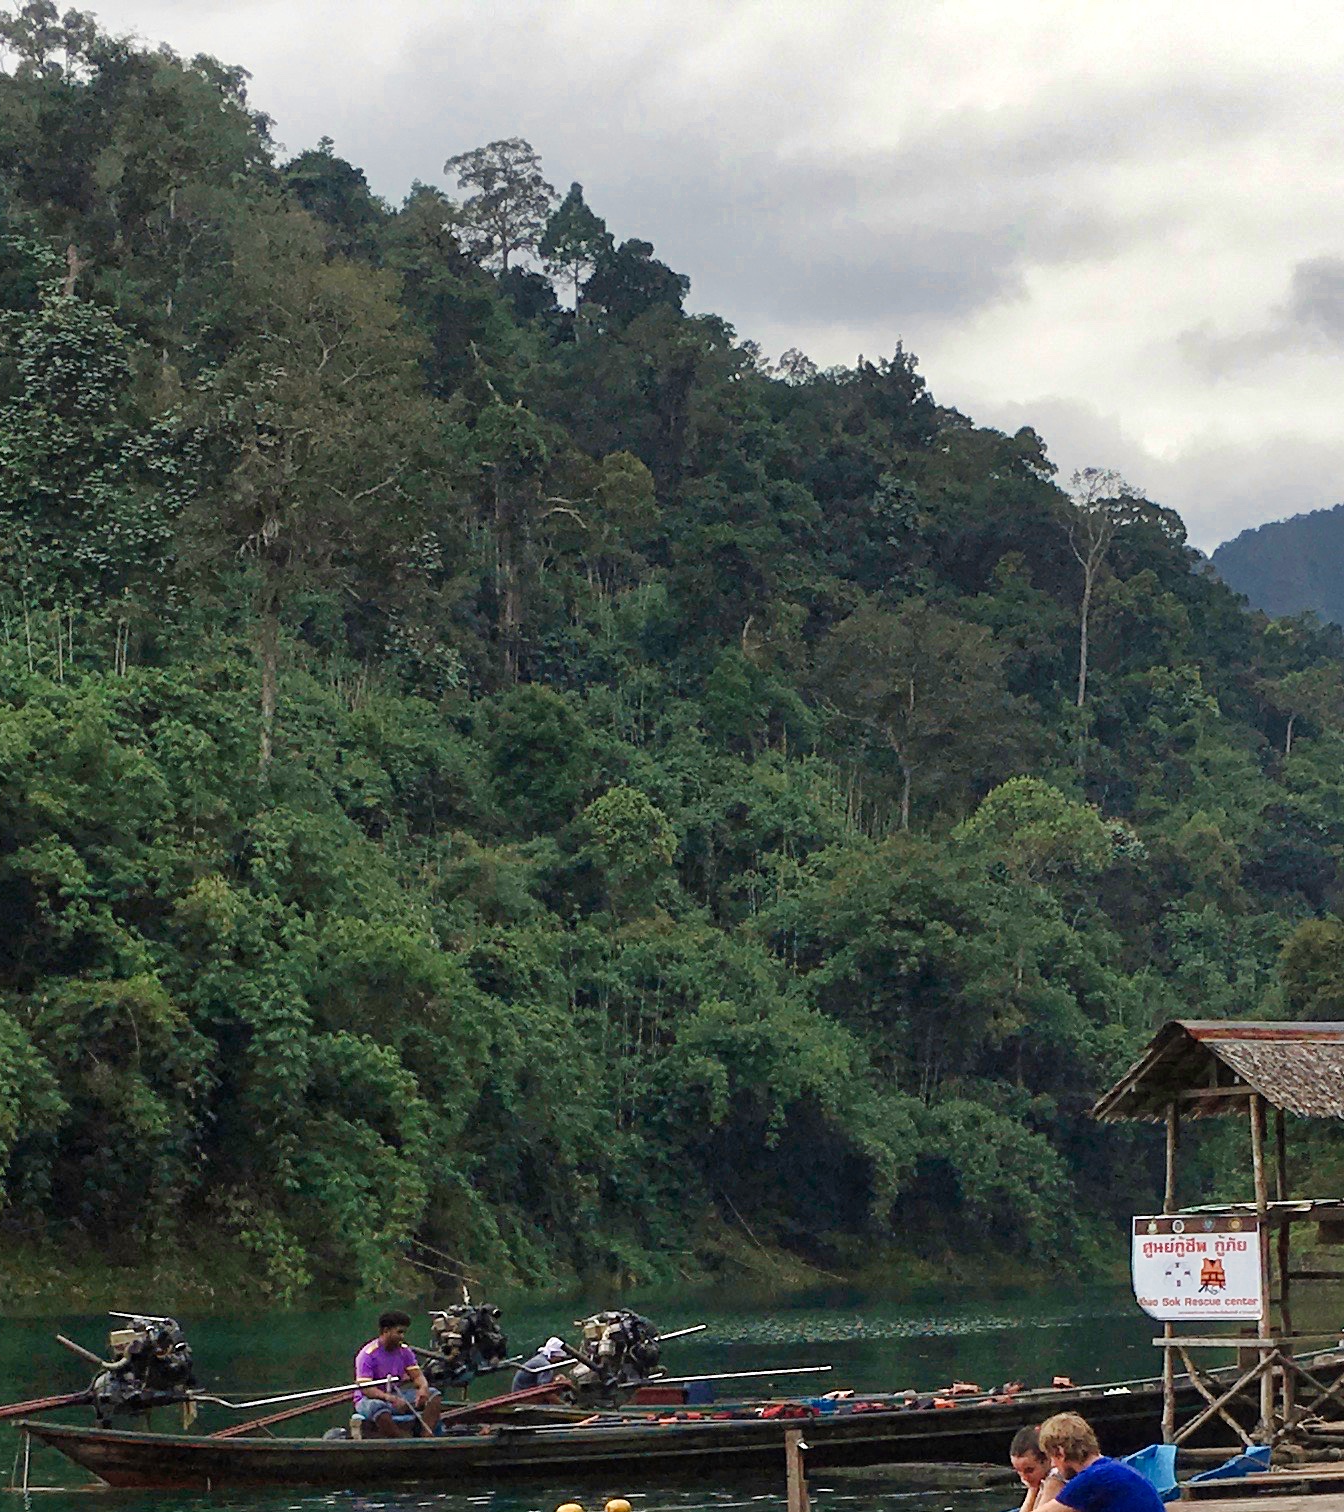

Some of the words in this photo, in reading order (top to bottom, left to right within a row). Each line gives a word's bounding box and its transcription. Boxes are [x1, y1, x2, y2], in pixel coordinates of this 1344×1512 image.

[1142, 1236, 1207, 1258] ศูนย์กู้ชีพ
[1214, 1234, 1247, 1257] กู้ภัย
[1162, 1297, 1181, 1307] Sok
[1184, 1297, 1221, 1307] Rescue
[1224, 1297, 1259, 1306] center
